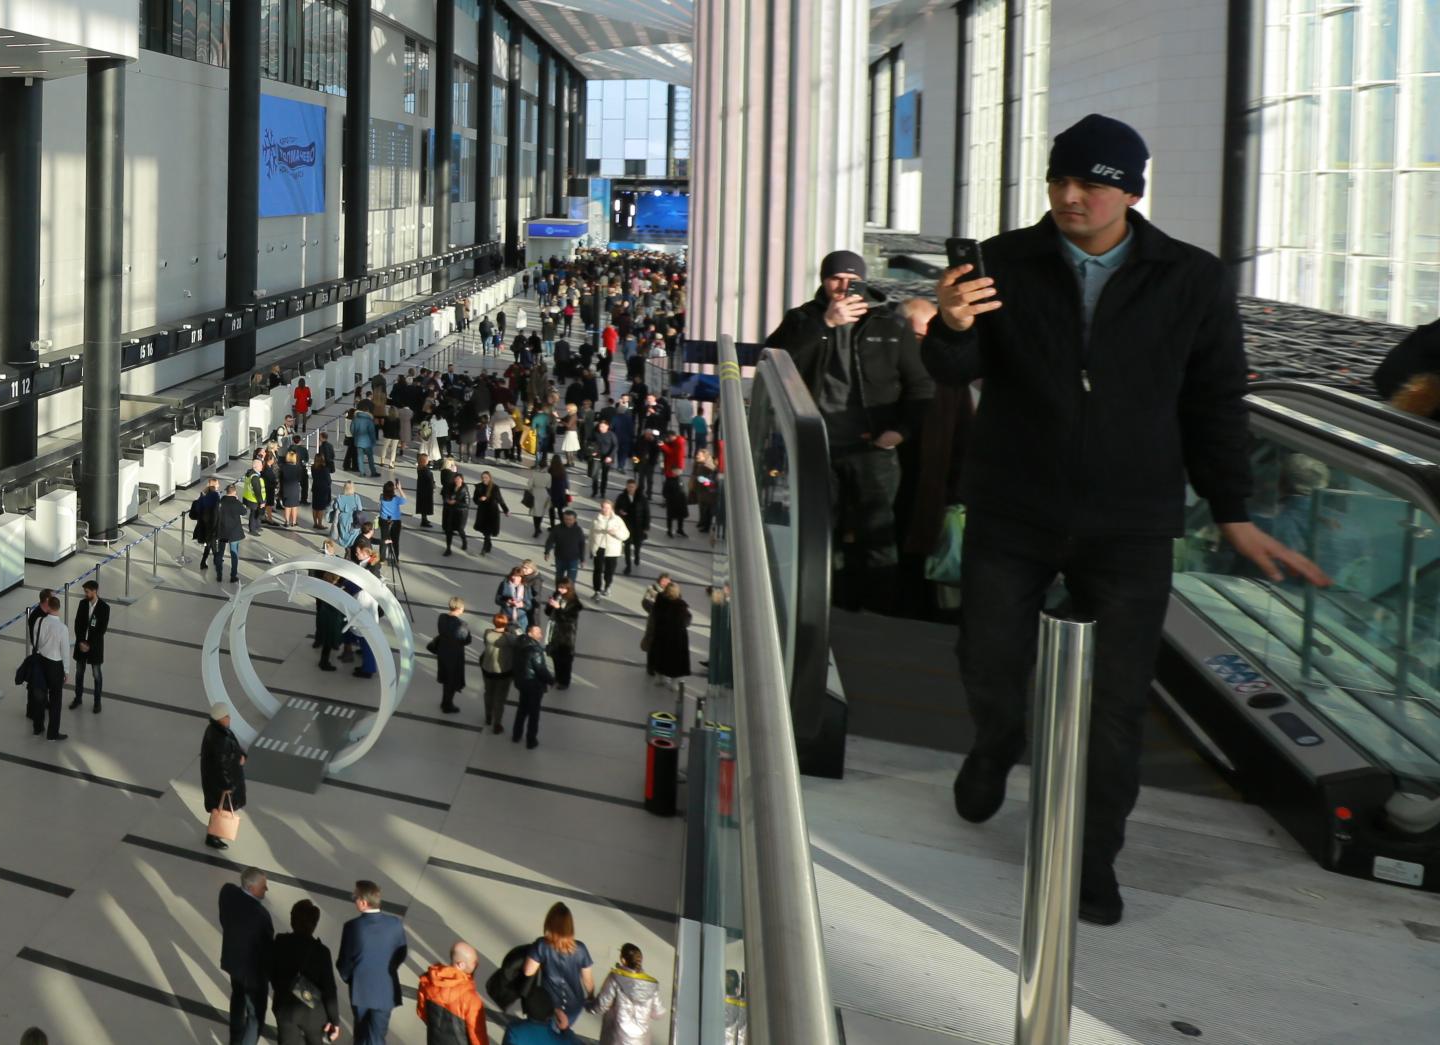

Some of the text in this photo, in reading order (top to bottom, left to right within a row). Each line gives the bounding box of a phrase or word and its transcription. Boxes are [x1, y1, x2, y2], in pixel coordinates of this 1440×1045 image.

[1091, 163, 1125, 180] UFC
[11, 377, 30, 398] 11 12
